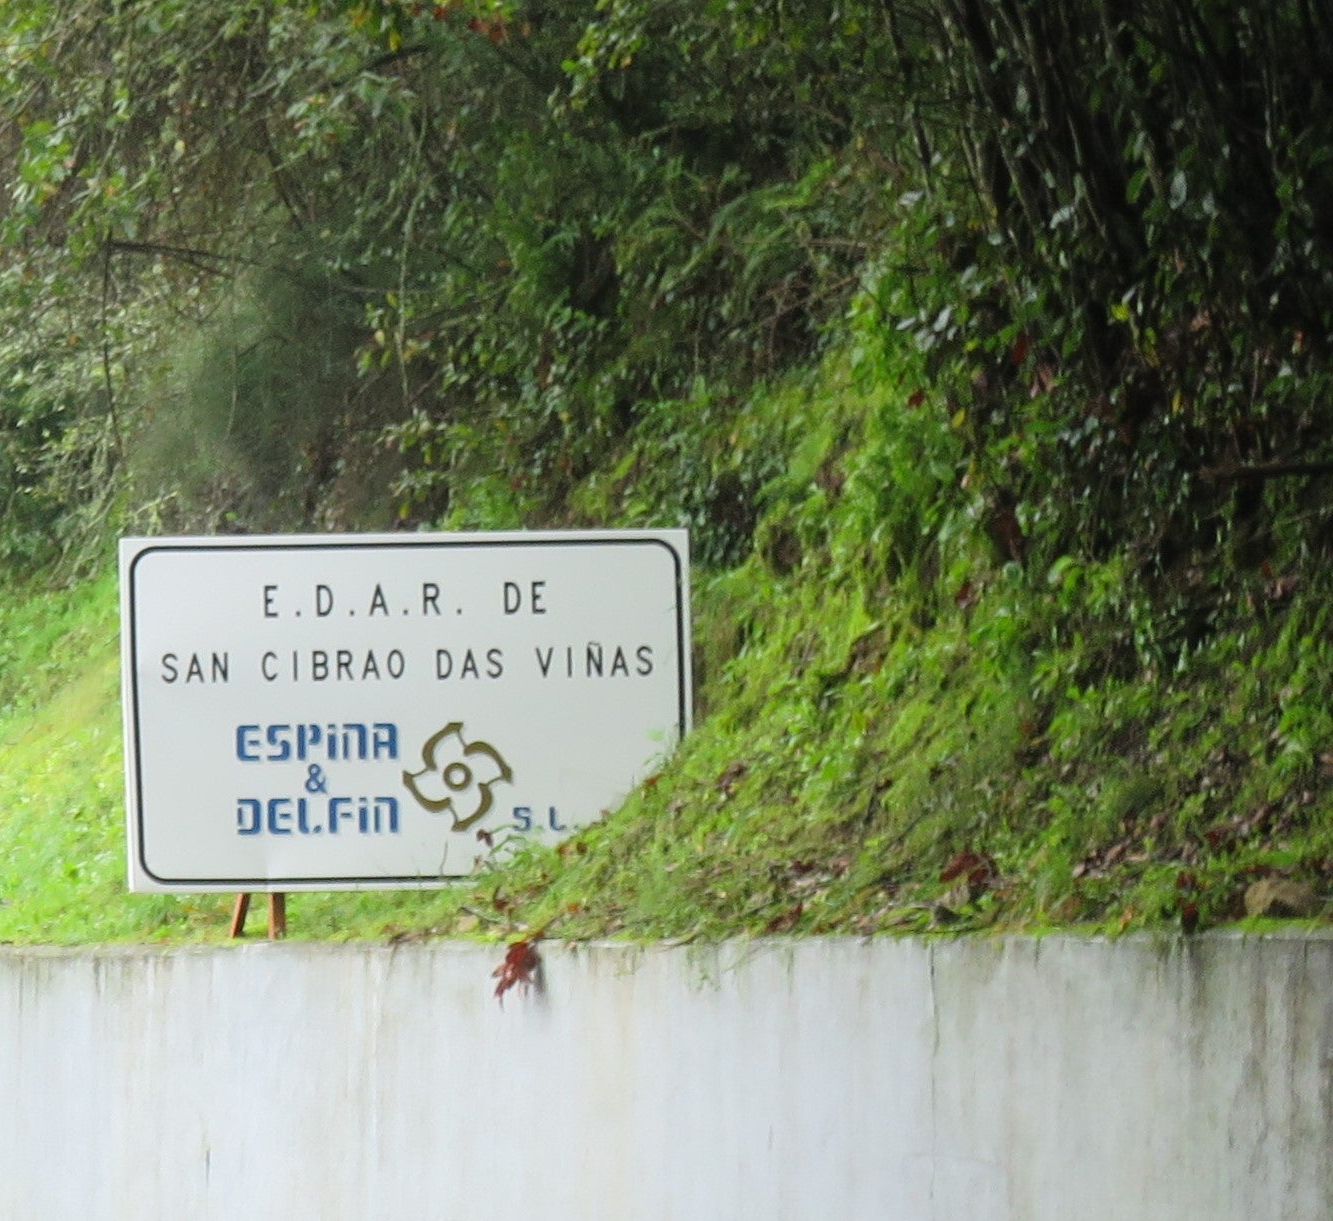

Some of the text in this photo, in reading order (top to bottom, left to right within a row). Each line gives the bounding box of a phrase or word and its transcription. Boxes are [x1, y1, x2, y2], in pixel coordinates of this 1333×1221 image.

[263, 580, 548, 618] E.D.A.R. DE
[160, 641, 654, 684] SAN CIBRAO DAS VIÑAS
[304, 763, 327, 794] &
[512, 806, 579, 832] SL.
